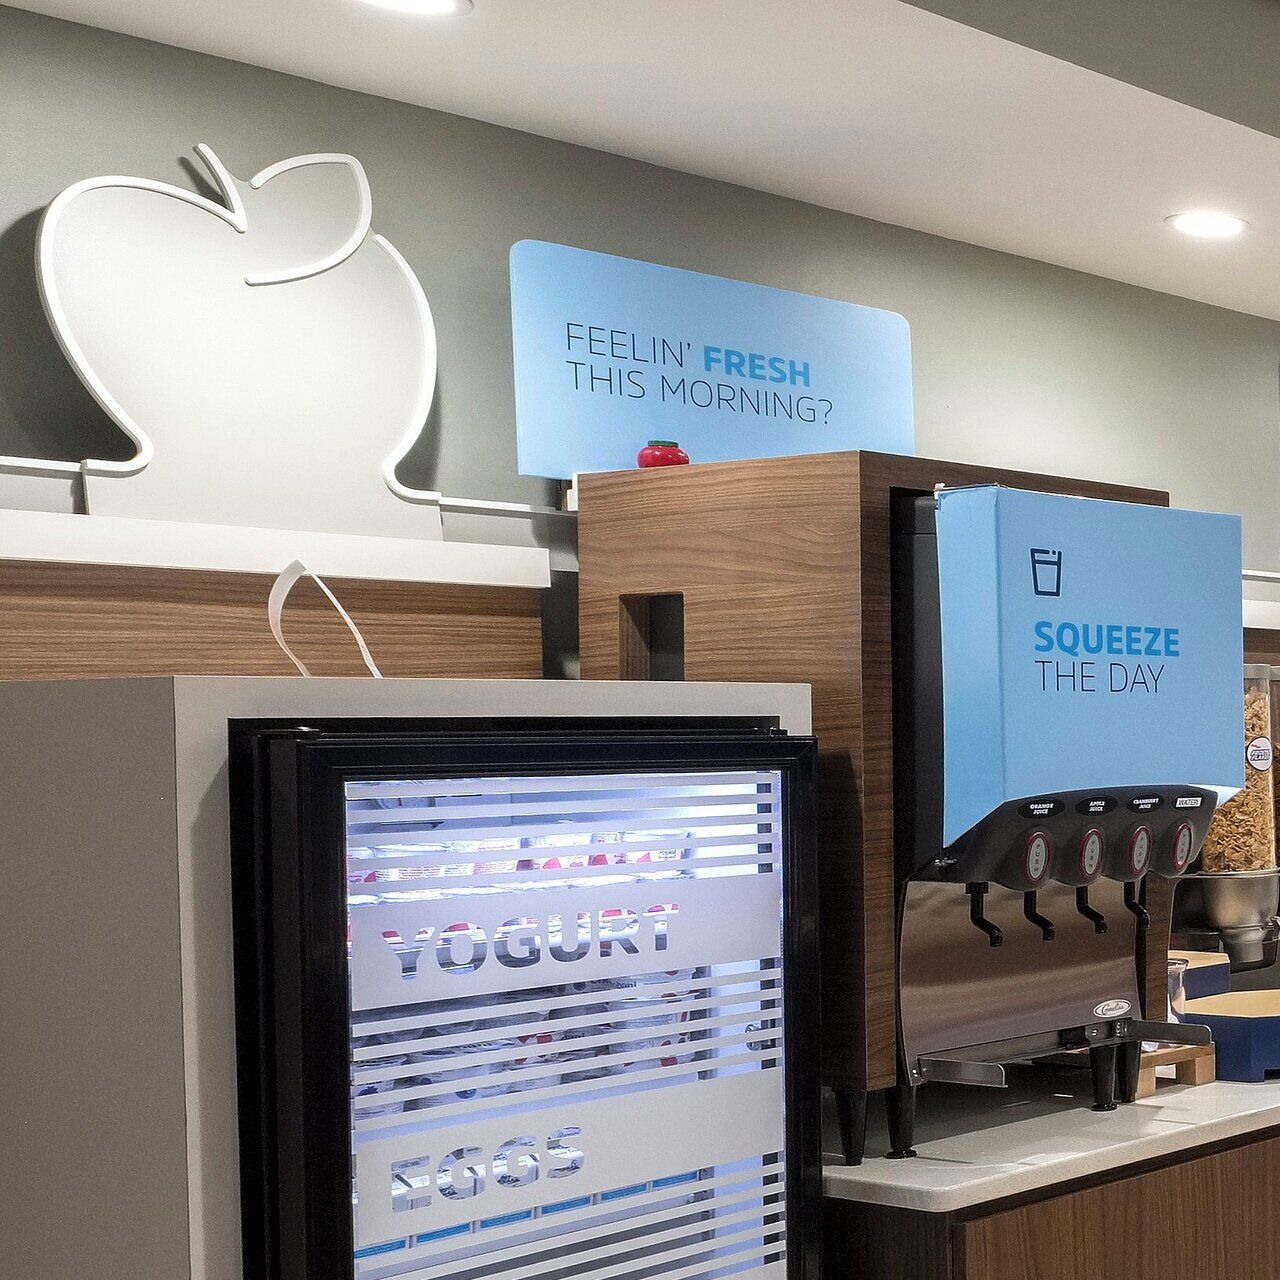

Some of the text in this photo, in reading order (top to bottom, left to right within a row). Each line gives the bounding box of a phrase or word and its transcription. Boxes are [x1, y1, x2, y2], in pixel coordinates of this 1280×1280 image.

[565, 359, 833, 425] THIS MORNING?
[703, 344, 810, 388] FRESH
[1034, 620, 1180, 657] SQUEEZE
[1034, 660, 1165, 693] THE DAY
[381, 903, 680, 981] YOGURT
[391, 1126, 585, 1213] EGGS
